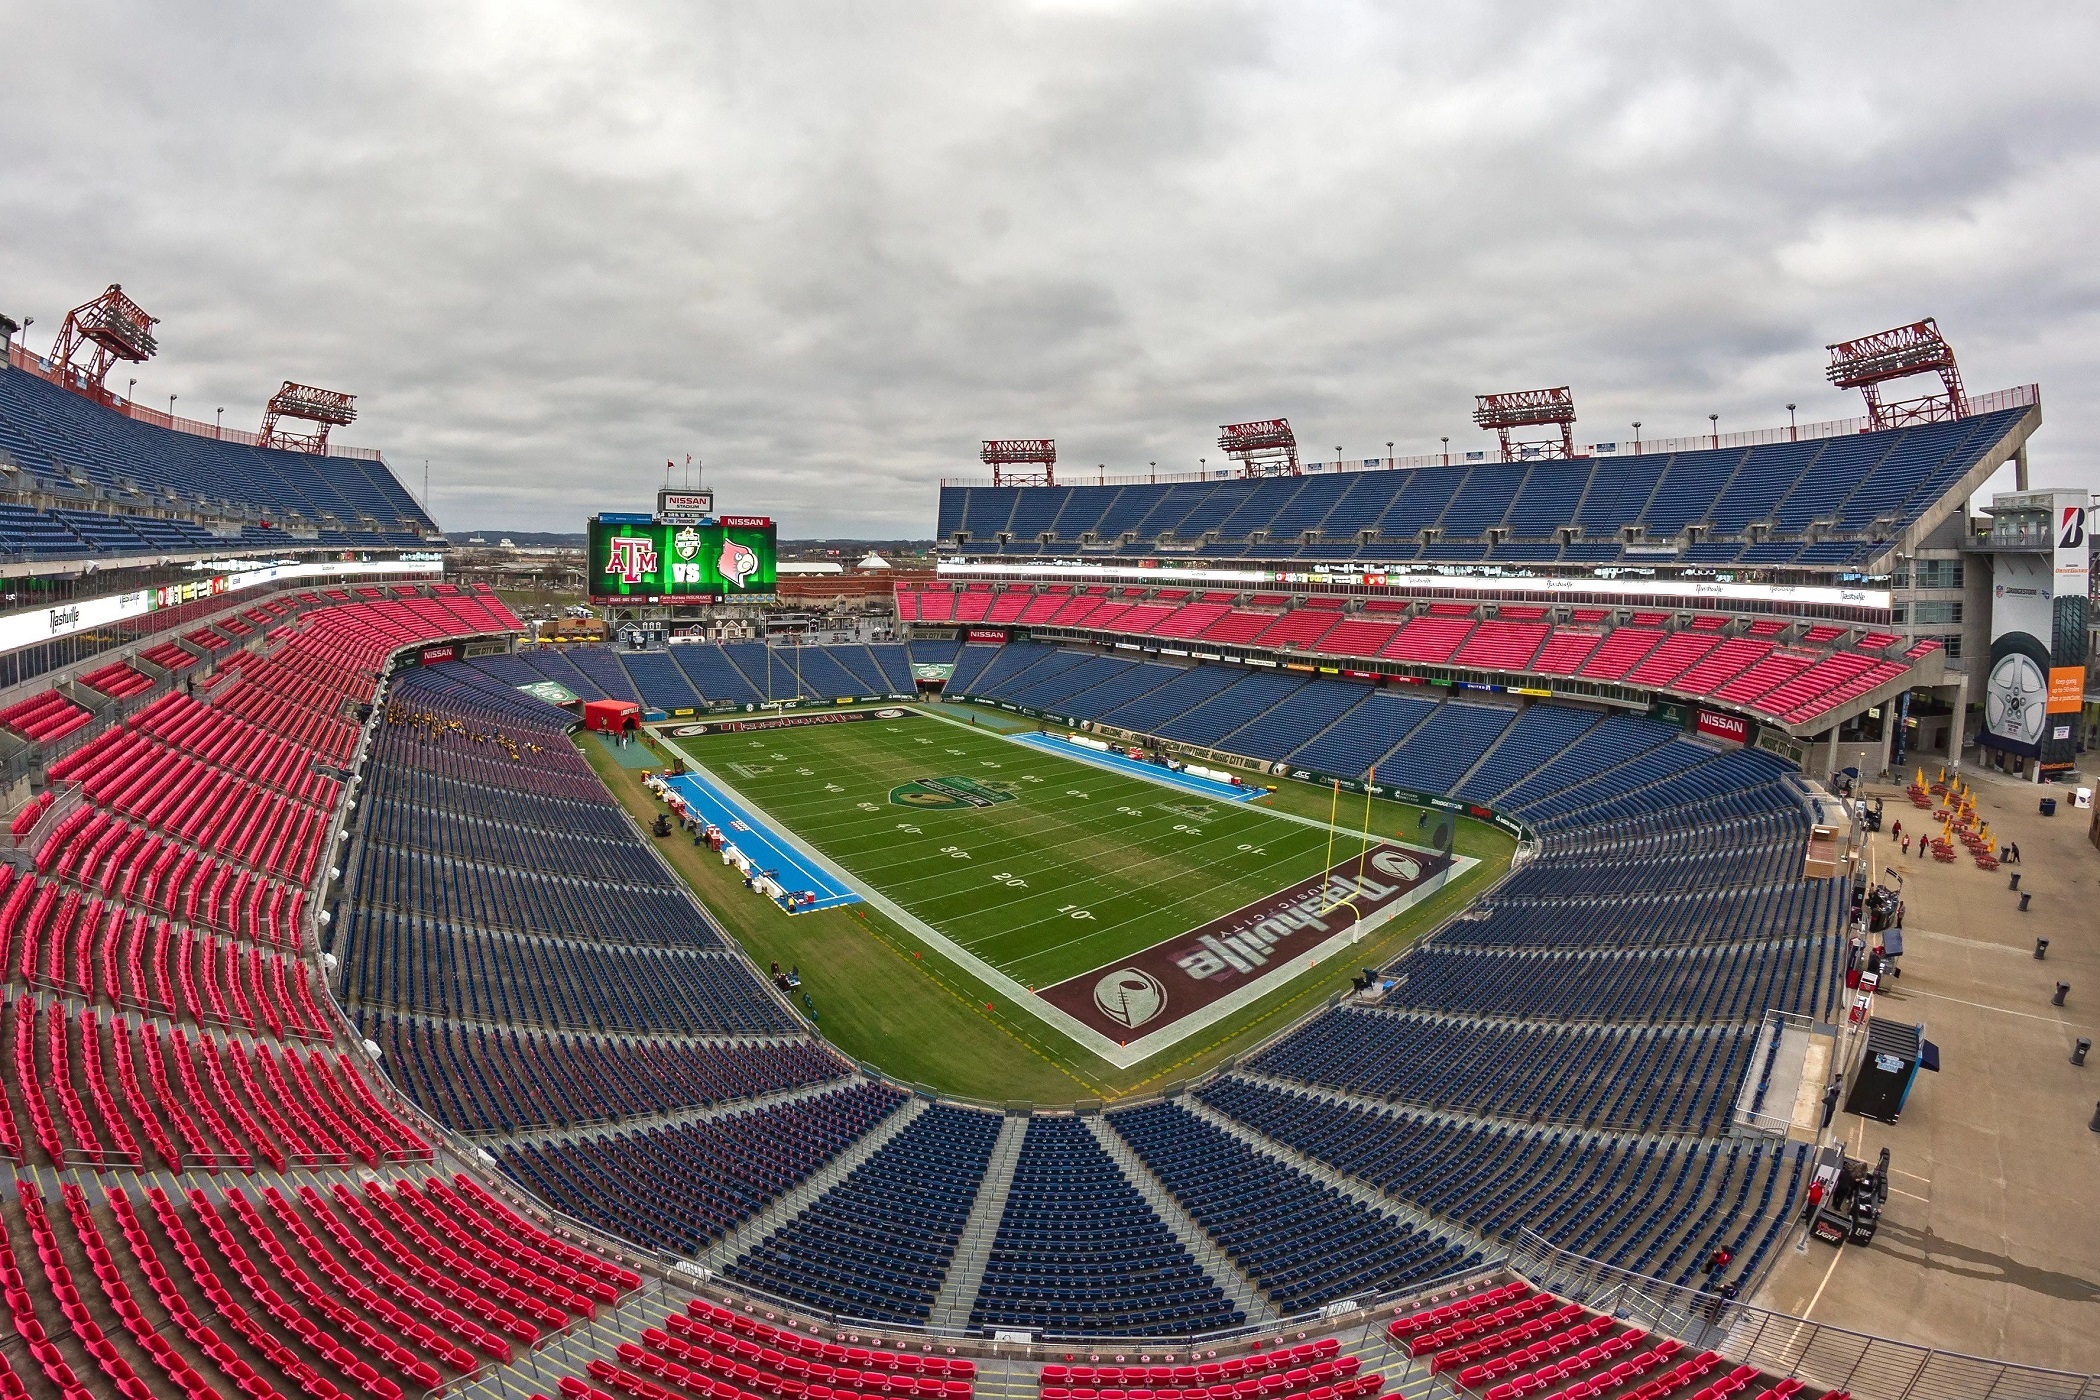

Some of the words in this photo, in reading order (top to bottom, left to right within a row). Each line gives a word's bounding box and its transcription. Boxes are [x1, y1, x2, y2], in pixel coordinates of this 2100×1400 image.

[669, 497, 707, 505] NISSAN
[727, 518, 764, 526] NISSAN
[672, 563, 701, 583] VS
[49, 605, 80, 635] Nashville
[970, 631, 1004, 639] NISSAN
[424, 648, 453, 660] NISSAN
[1700, 712, 1743, 734] NISSAN
[1099, 725, 1124, 739] WELCOME
[1180, 743, 1210, 760] MORTGAGE
[1210, 750, 1228, 764] MUSIC
[1228, 754, 1244, 768] CITY
[1244, 758, 1262, 771] BOWL
[1292, 770, 1312, 780] ACC
[856, 802, 880, 812] 50
[1116, 806, 1142, 818] 30
[896, 823, 921, 834] 40
[1173, 824, 1203, 836] 20
[939, 846, 968, 859] 30
[1237, 843, 1263, 856] 10
[992, 872, 1026, 888] 20
[1278, 882, 1332, 909] MUSIC
[1056, 904, 1091, 919] 10
[1177, 874, 1400, 981] Nashville
[1220, 914, 1265, 938] CITY
[1815, 1229, 1839, 1242] LIGHT
